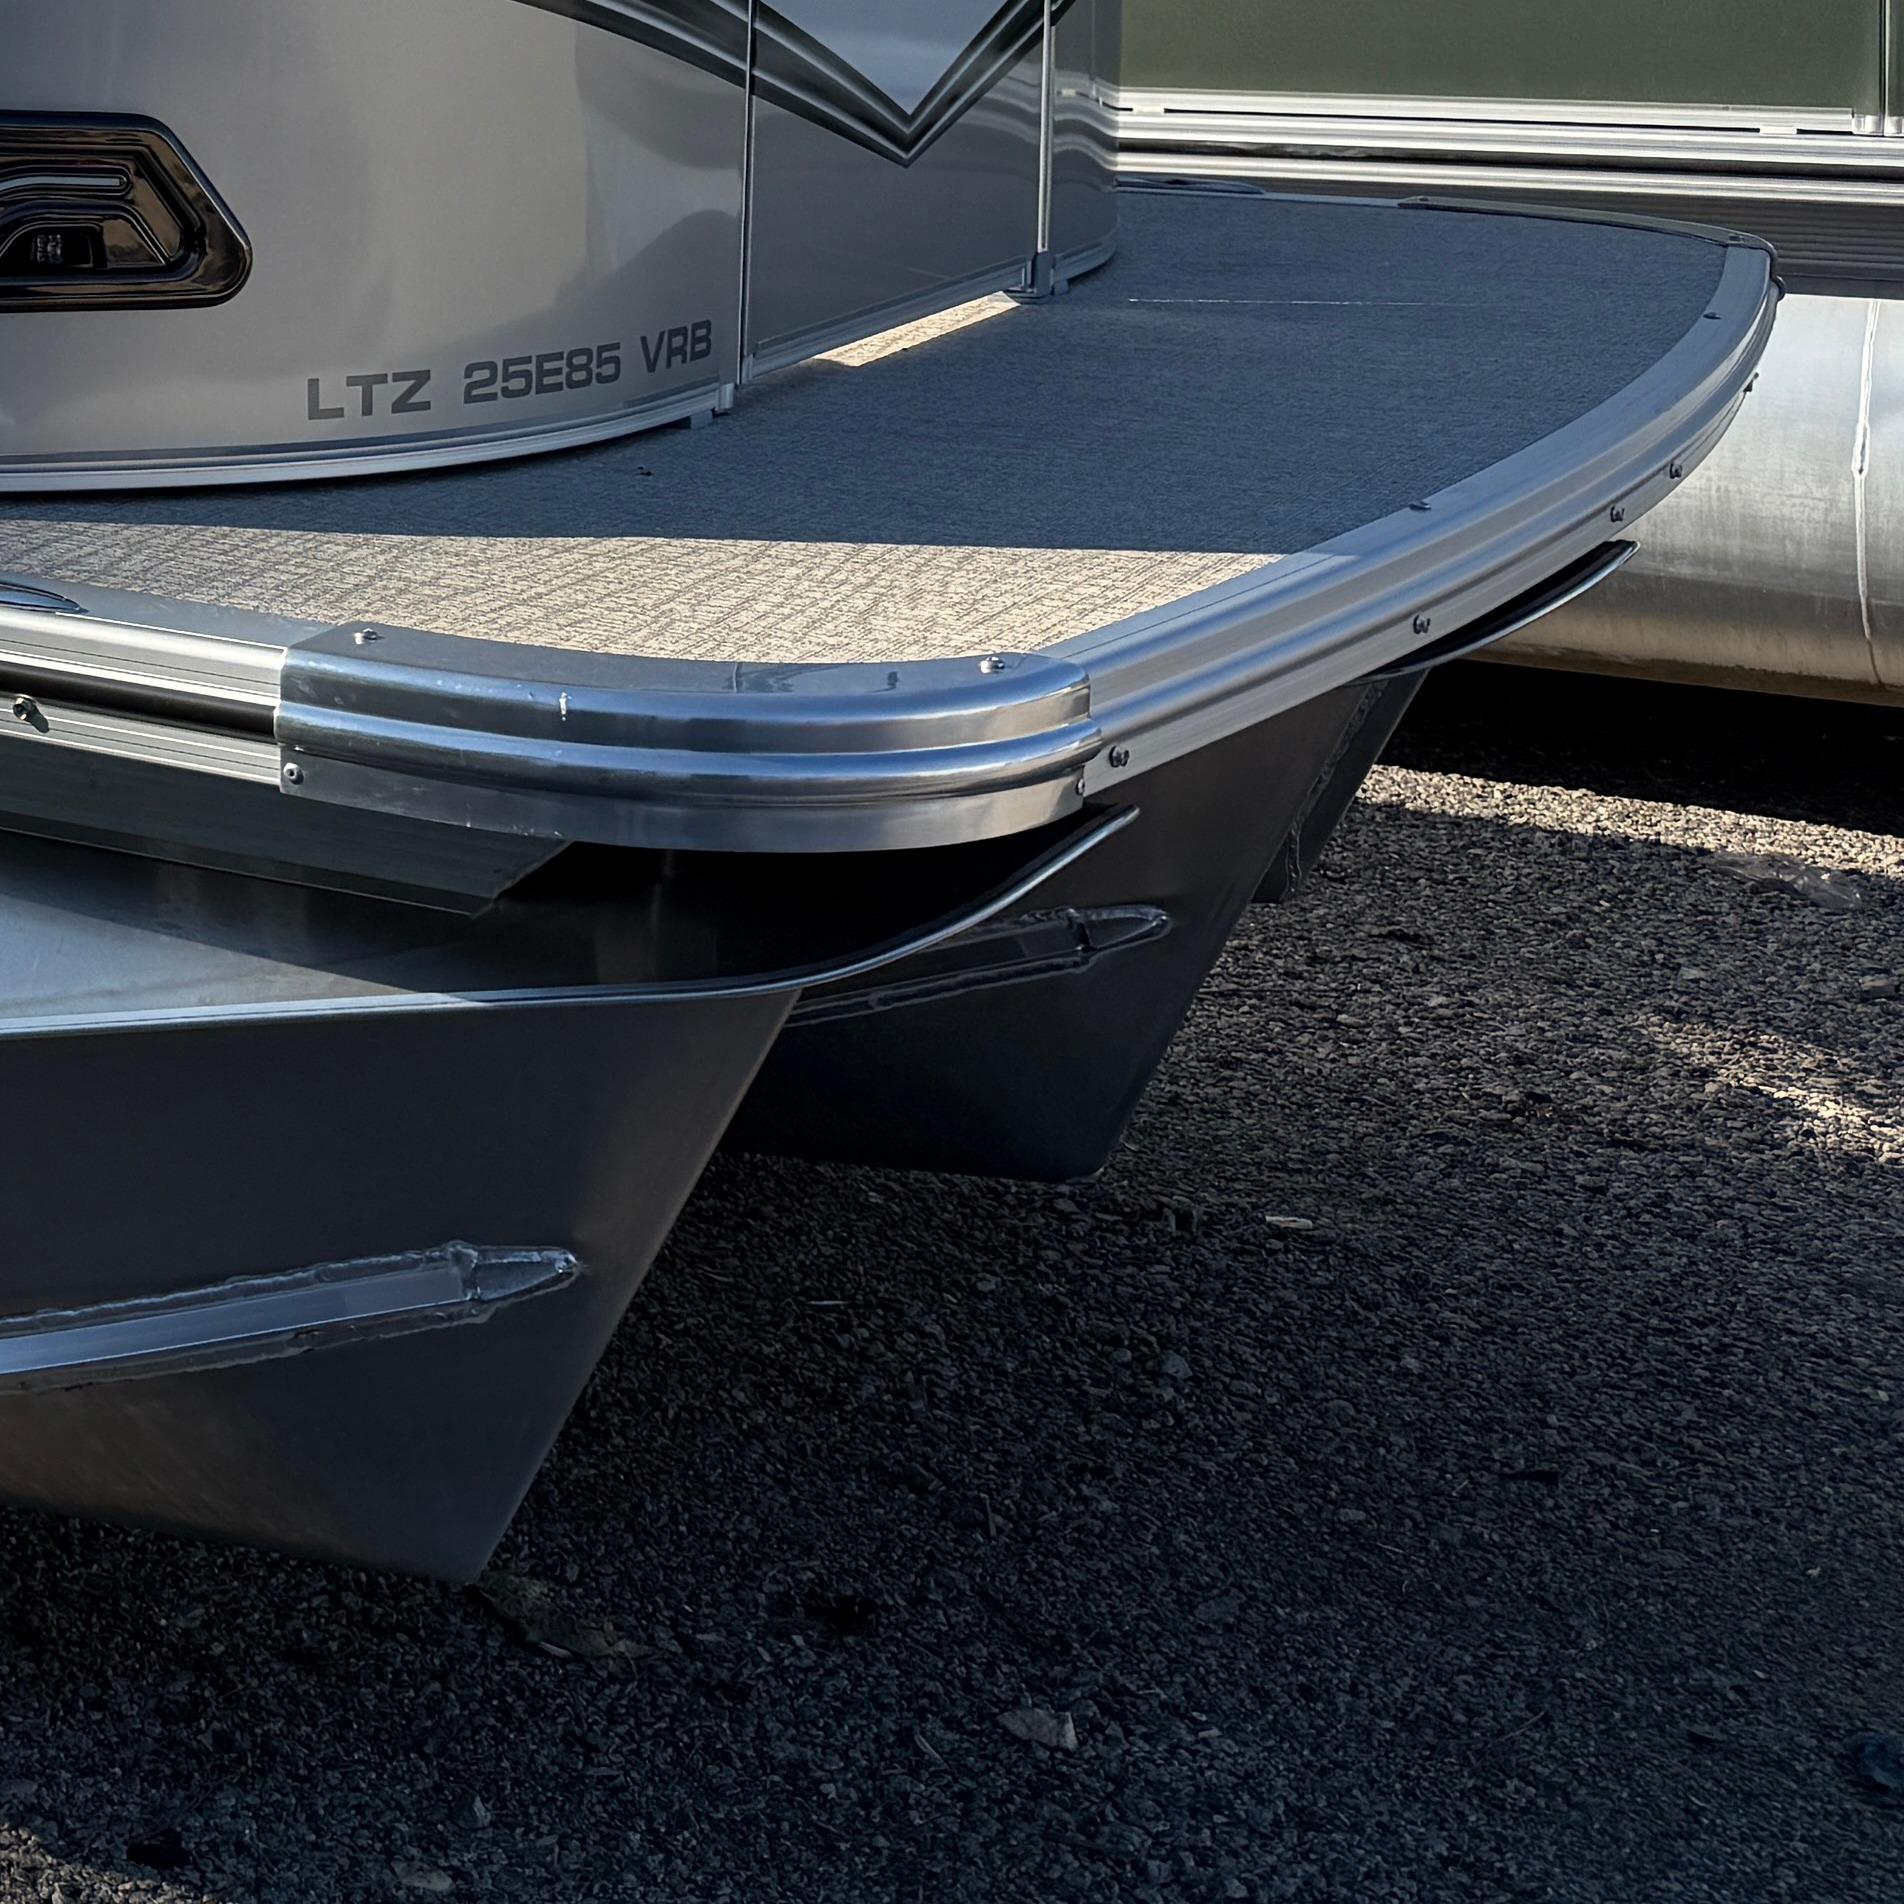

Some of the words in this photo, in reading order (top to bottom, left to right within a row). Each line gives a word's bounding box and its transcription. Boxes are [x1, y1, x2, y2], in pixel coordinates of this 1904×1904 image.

[308, 369, 431, 421] LTZ
[464, 342, 621, 405] 25E85
[640, 319, 712, 373] VRB
